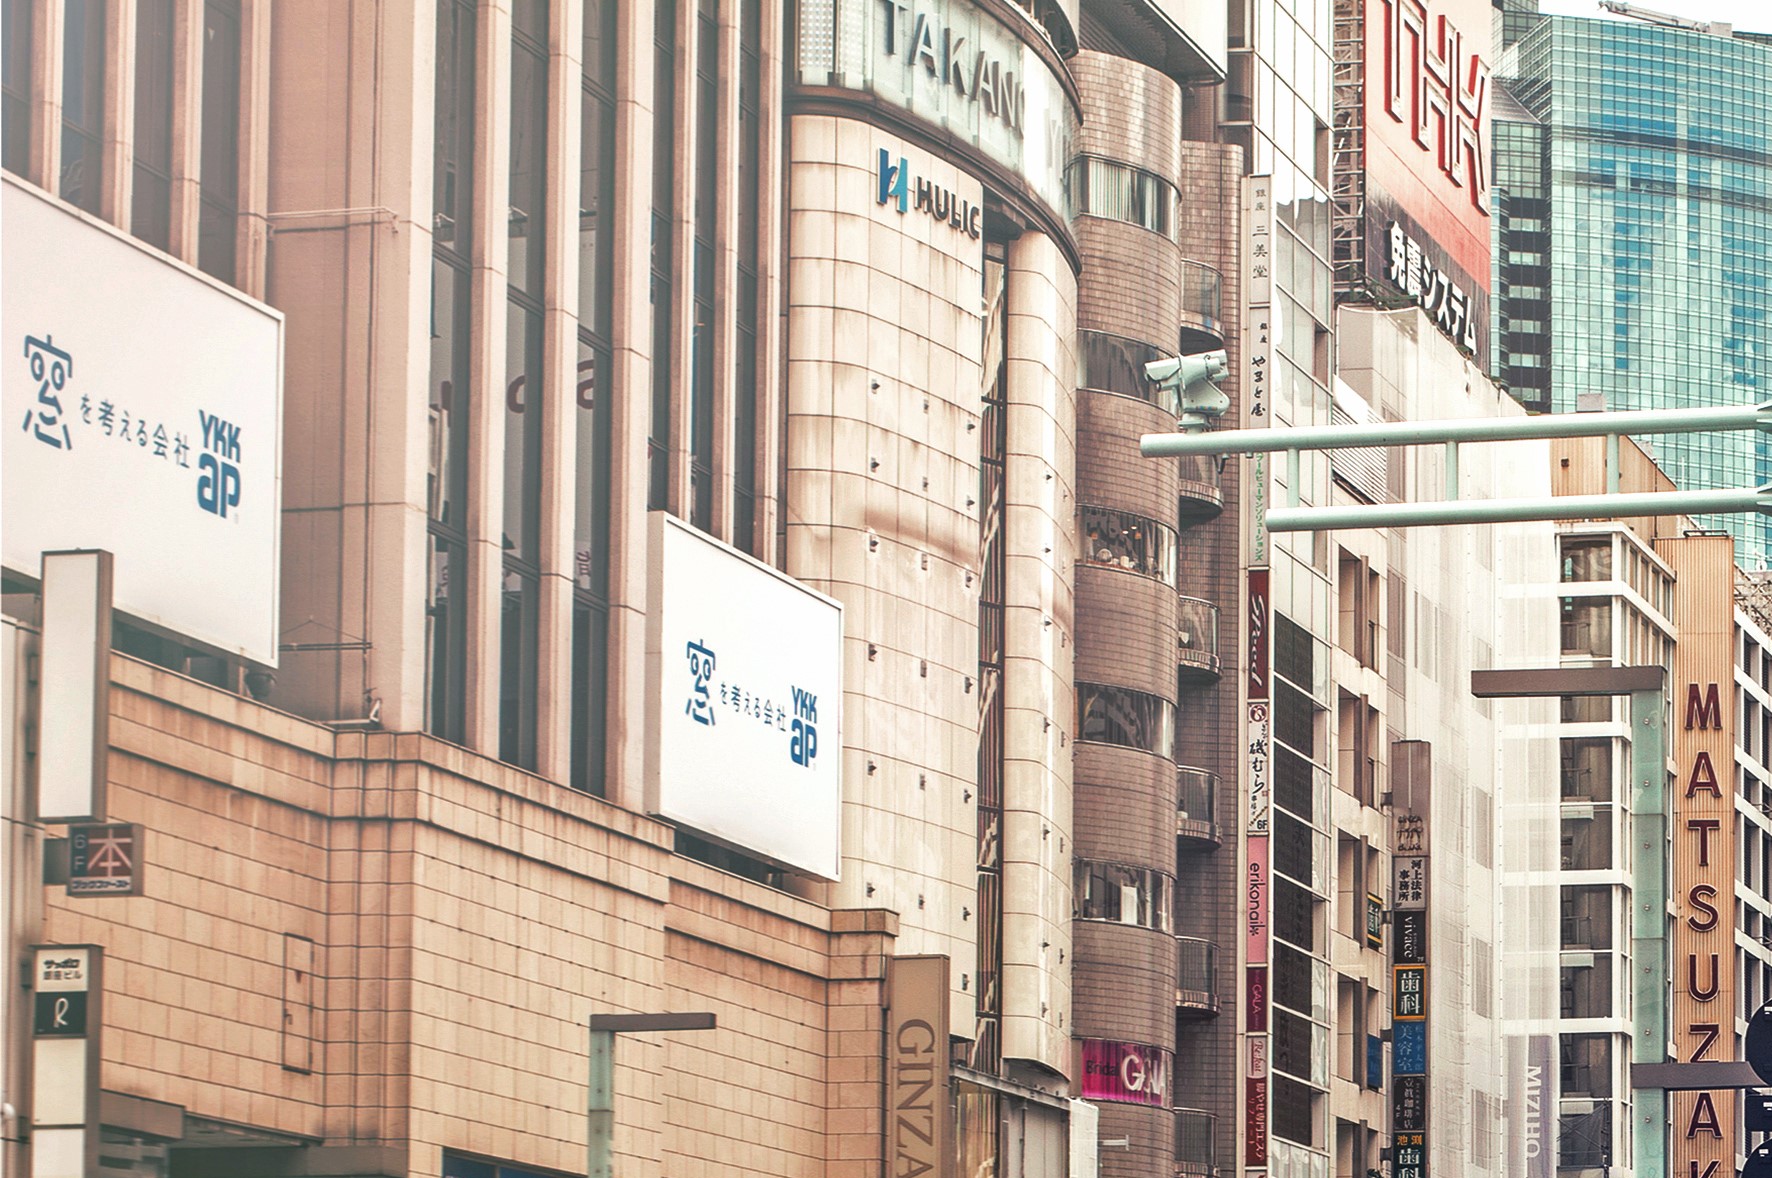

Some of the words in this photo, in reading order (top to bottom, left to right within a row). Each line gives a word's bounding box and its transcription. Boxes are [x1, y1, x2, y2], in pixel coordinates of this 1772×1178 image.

[914, 176, 980, 240] HULIC
[198, 409, 242, 464] YKK
[791, 685, 818, 724] YKK
[1399, 970, 1421, 1015] 歯科
[1397, 1024, 1412, 1072] 美容室
